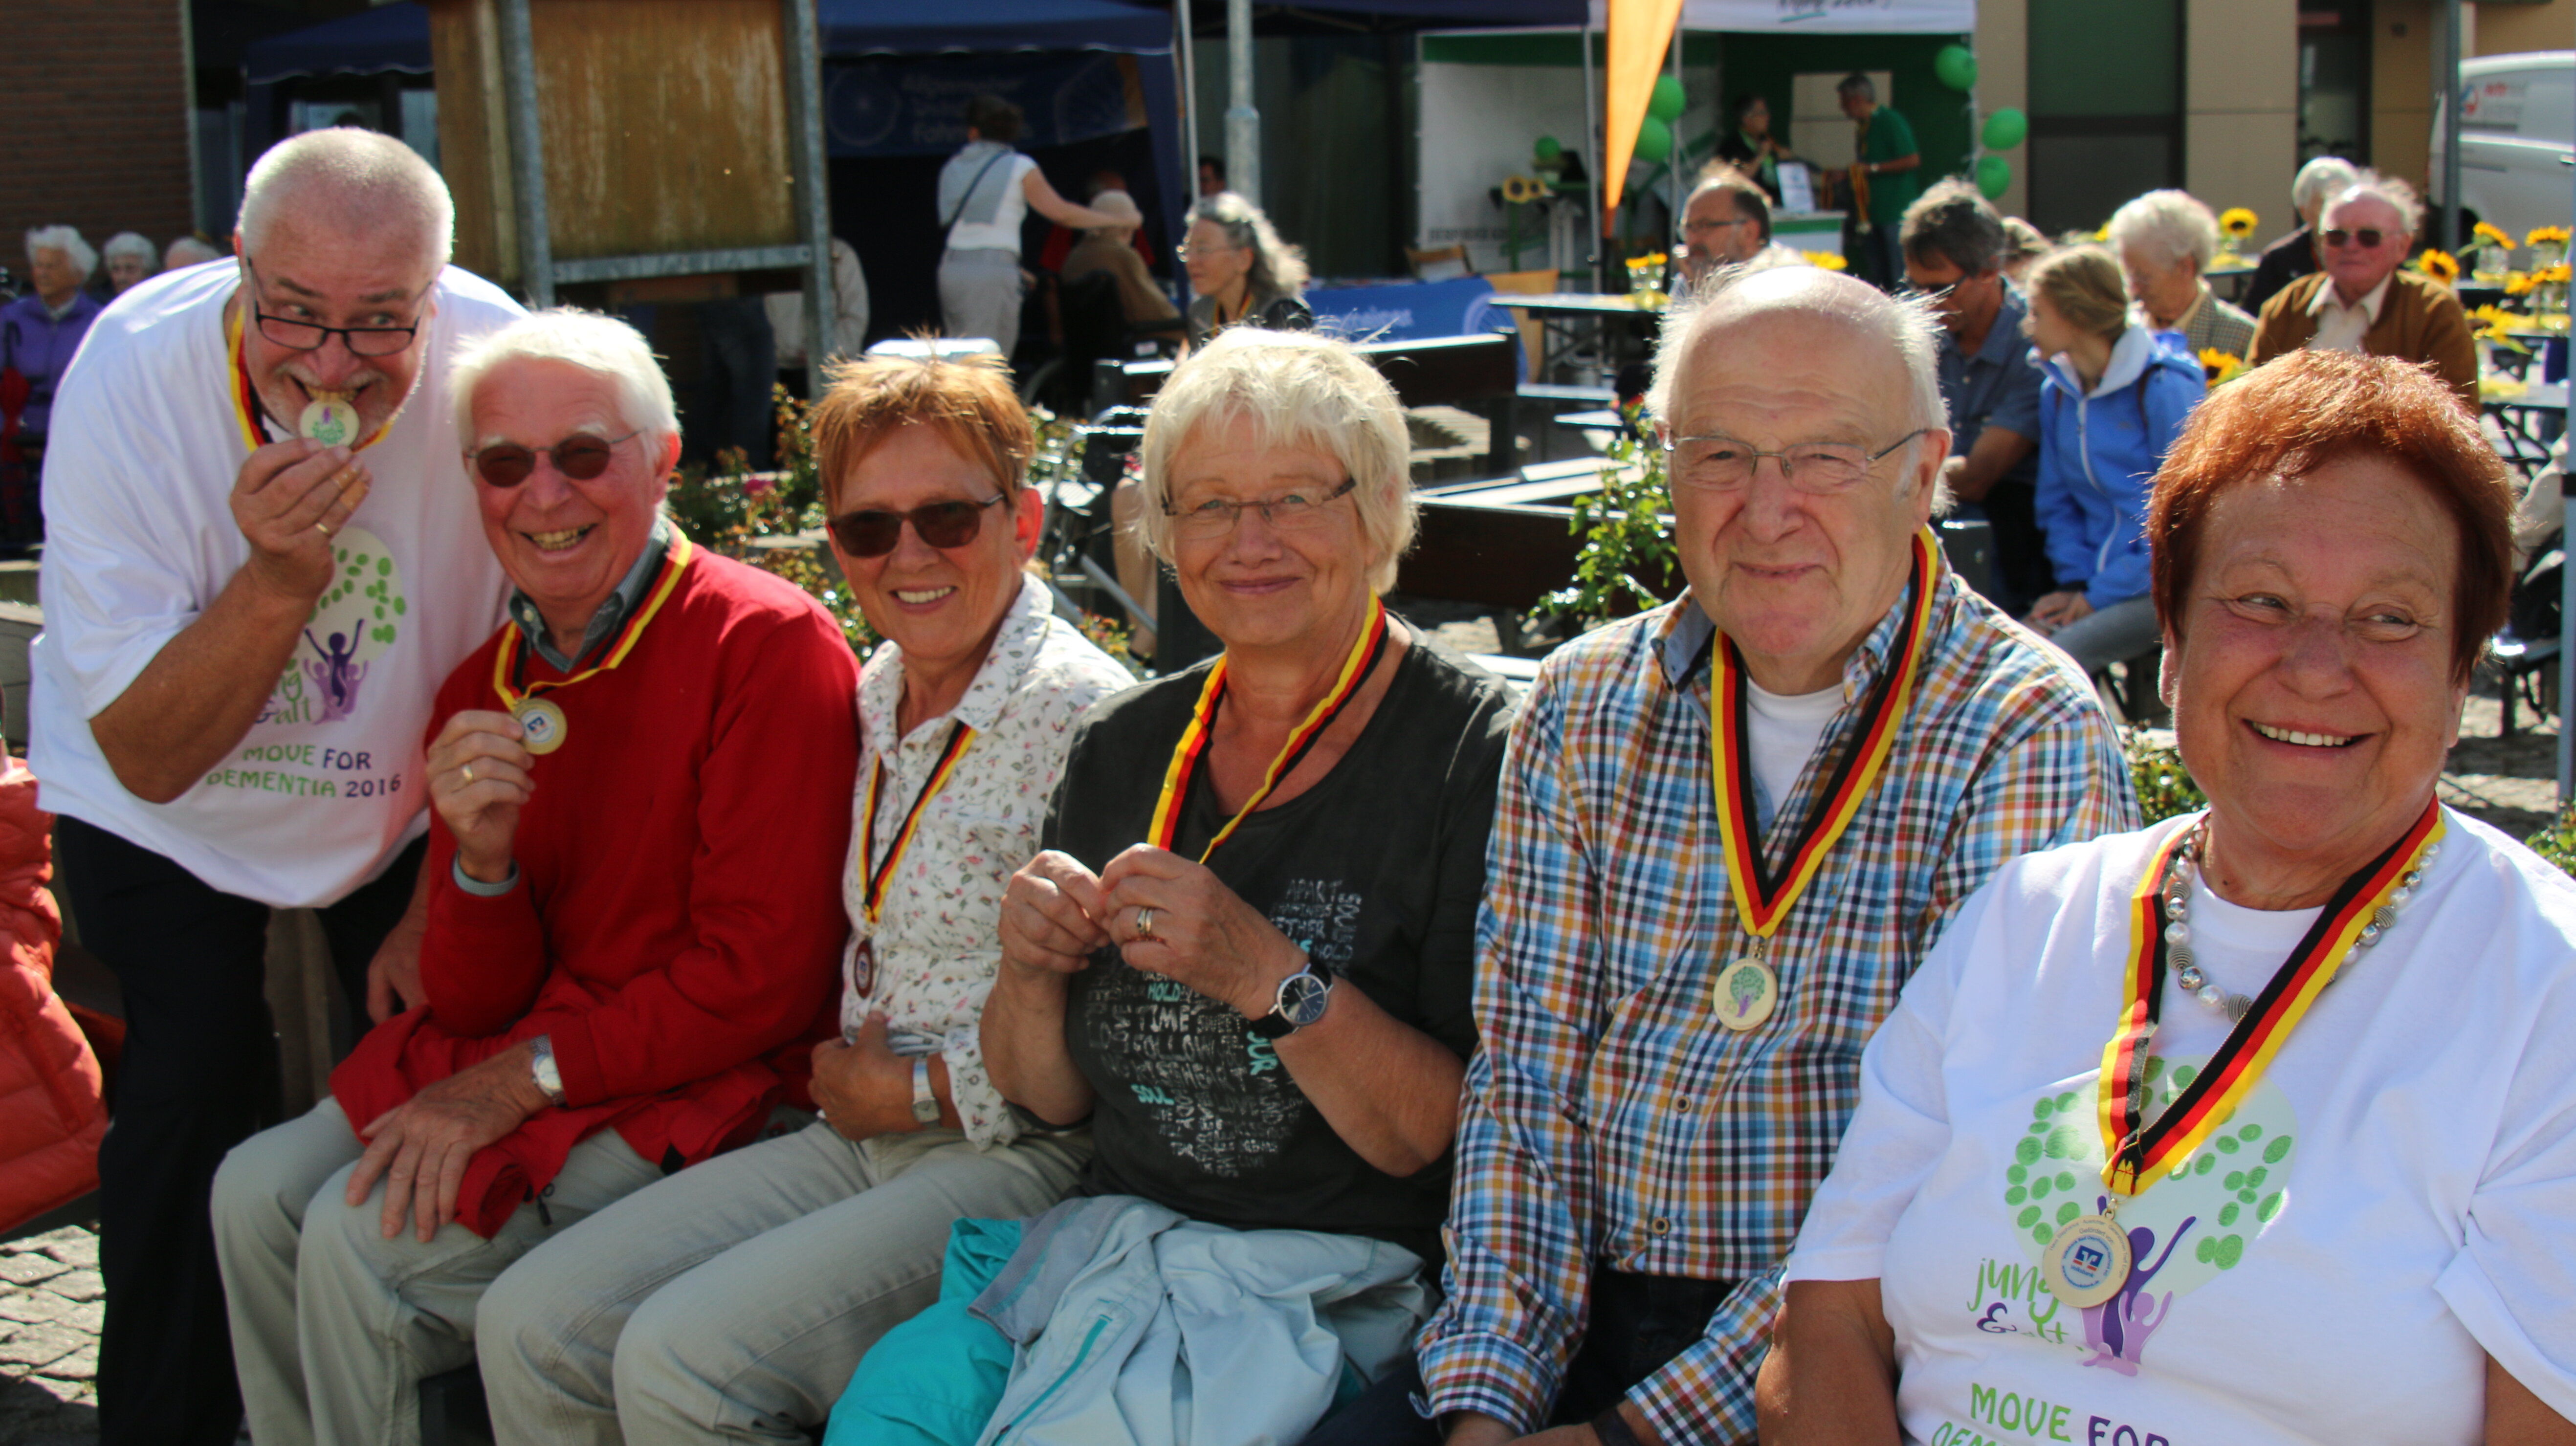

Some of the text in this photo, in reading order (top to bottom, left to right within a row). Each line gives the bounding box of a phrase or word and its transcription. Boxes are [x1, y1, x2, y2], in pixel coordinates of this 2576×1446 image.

[242, 745, 372, 770] MOVE FOR
[205, 768, 402, 798] DEMENTIA 2016
[1147, 982, 1181, 1002] HOLD
[1137, 1004, 1190, 1033] TIME
[1130, 1084, 1175, 1106] SOUL
[2070, 1264, 2094, 1277] Volksbank
[1976, 1302, 2017, 1334] &
[1970, 1382, 2071, 1443] MOVE
